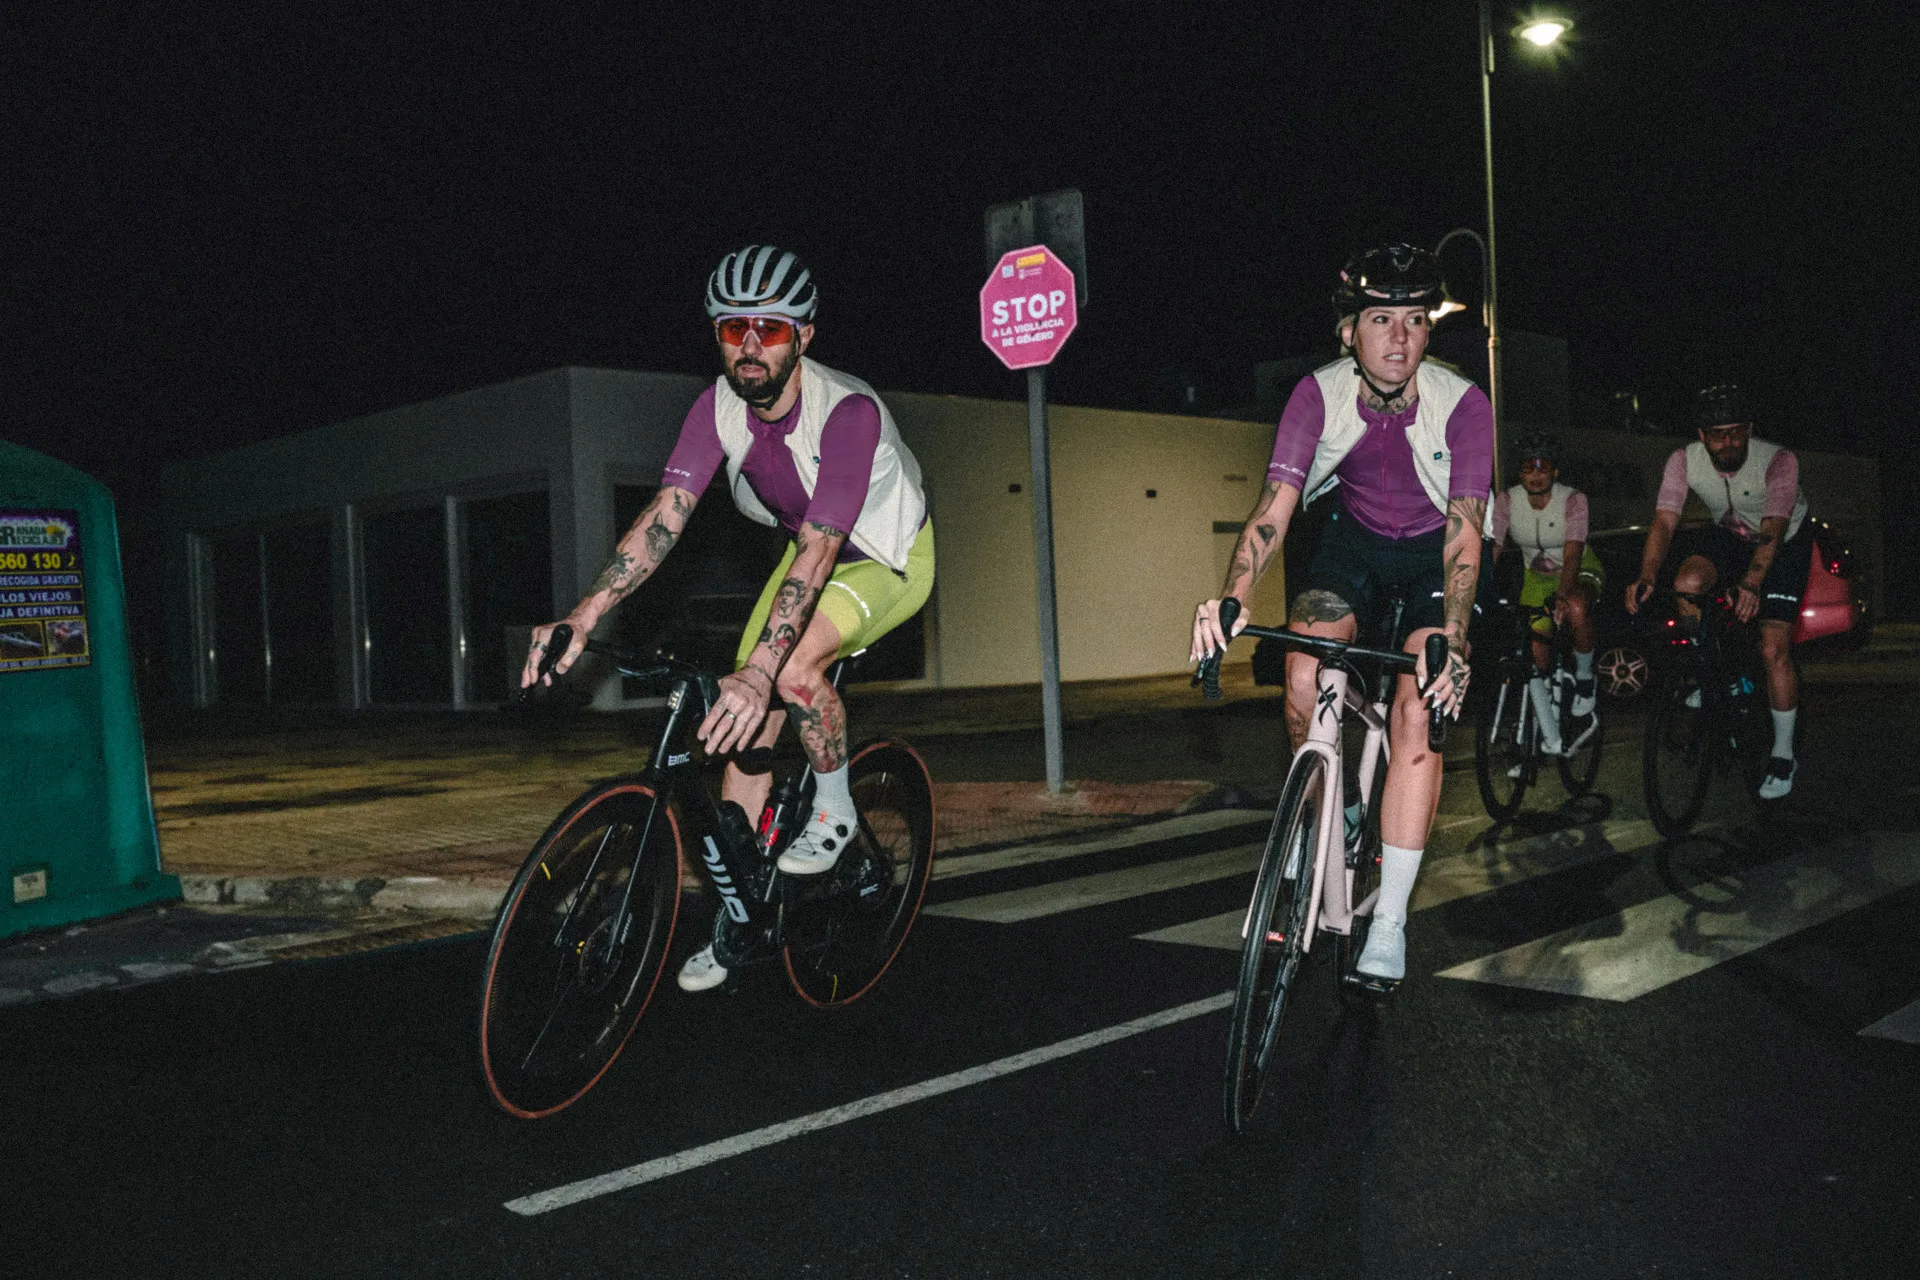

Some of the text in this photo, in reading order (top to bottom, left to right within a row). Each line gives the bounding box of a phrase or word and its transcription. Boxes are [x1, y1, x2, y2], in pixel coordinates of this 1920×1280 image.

[992, 290, 1066, 325] STOP
[991, 328, 999, 338] A
[1000, 326, 1012, 337] LA
[32, 552, 61, 569] 130
[42, 574, 79, 585] GRATUITA
[0, 591, 72, 603] LOS VIEJOS
[17, 605, 80, 617] DEFINITIVA
[667, 752, 691, 766] BMC
